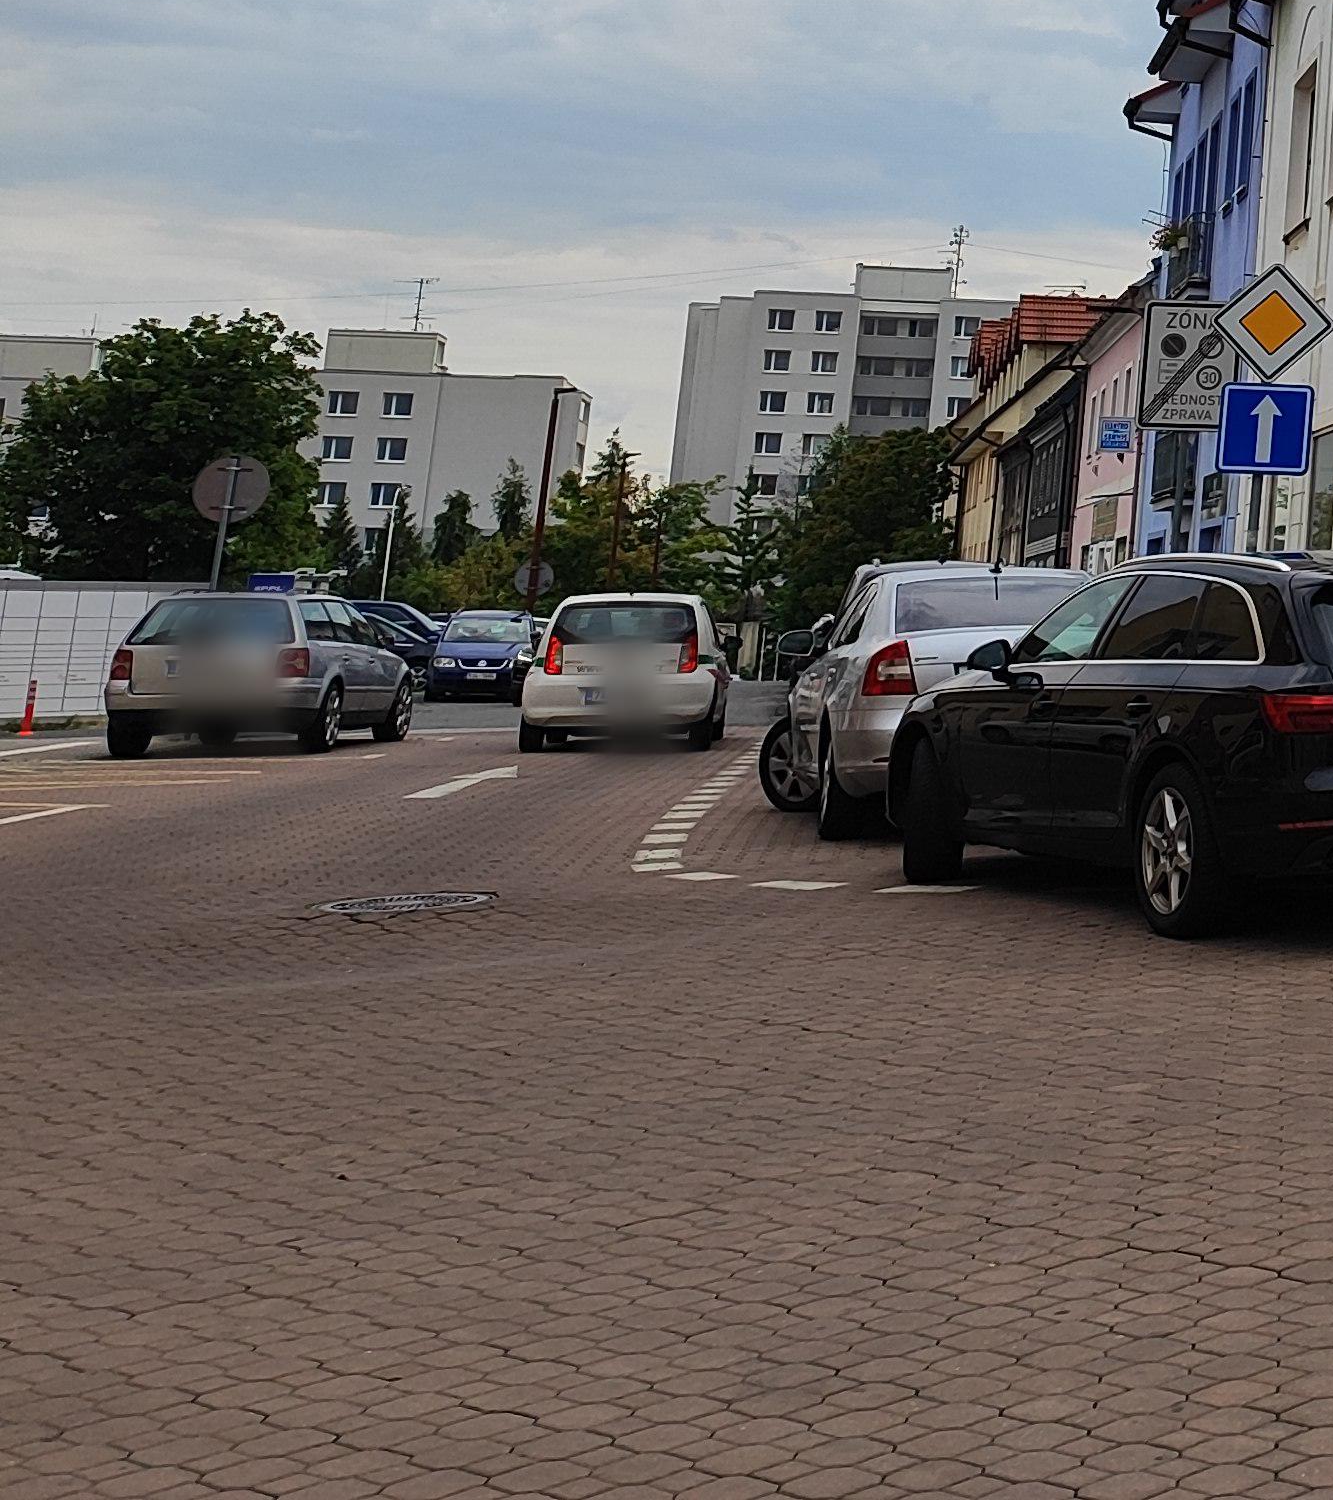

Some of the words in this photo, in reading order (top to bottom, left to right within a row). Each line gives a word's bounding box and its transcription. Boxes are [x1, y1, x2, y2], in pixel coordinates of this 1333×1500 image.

[1165, 309, 1213, 330] ZÓN
[1201, 371, 1217, 384] 30
[1154, 393, 1221, 406] EDNOST
[1161, 408, 1213, 420] ZPRAVA
